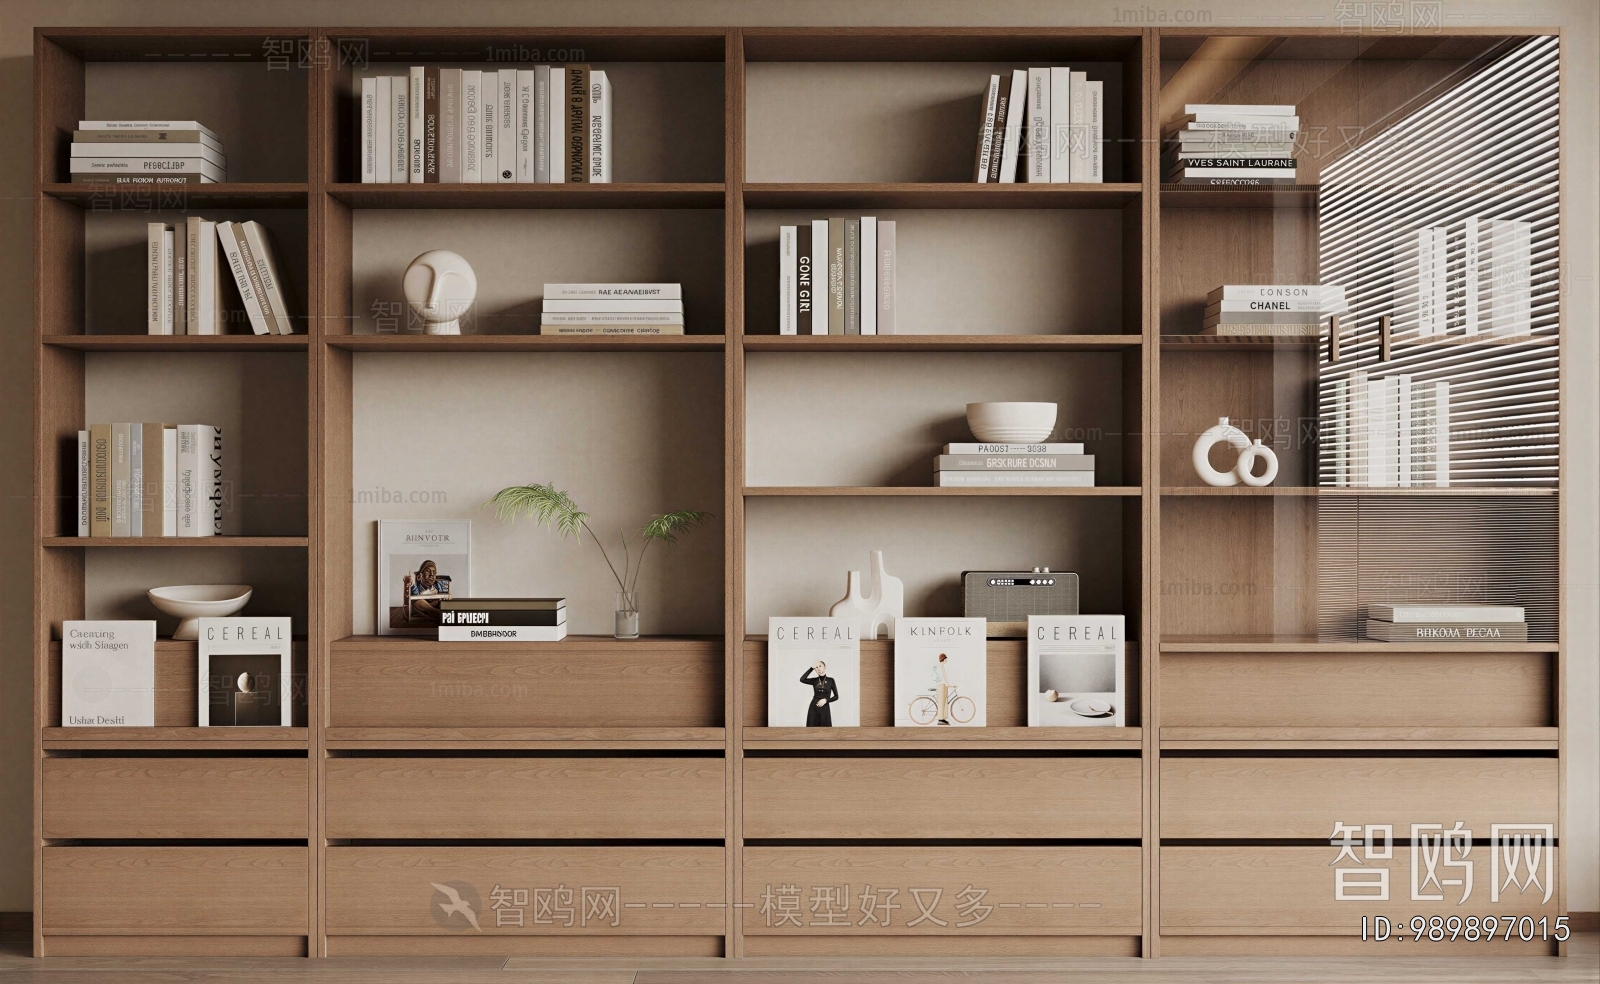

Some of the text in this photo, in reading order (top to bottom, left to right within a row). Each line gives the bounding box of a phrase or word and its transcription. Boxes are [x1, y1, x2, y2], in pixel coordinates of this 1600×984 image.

[1216, 159, 1245, 167] SAINT
[799, 256, 811, 314] GONE GIRL
[1250, 301, 1291, 310] CHANEL
[207, 626, 282, 641] CEREAL
[776, 626, 853, 640] CEREAL
[1037, 626, 1117, 640] CEREAL
